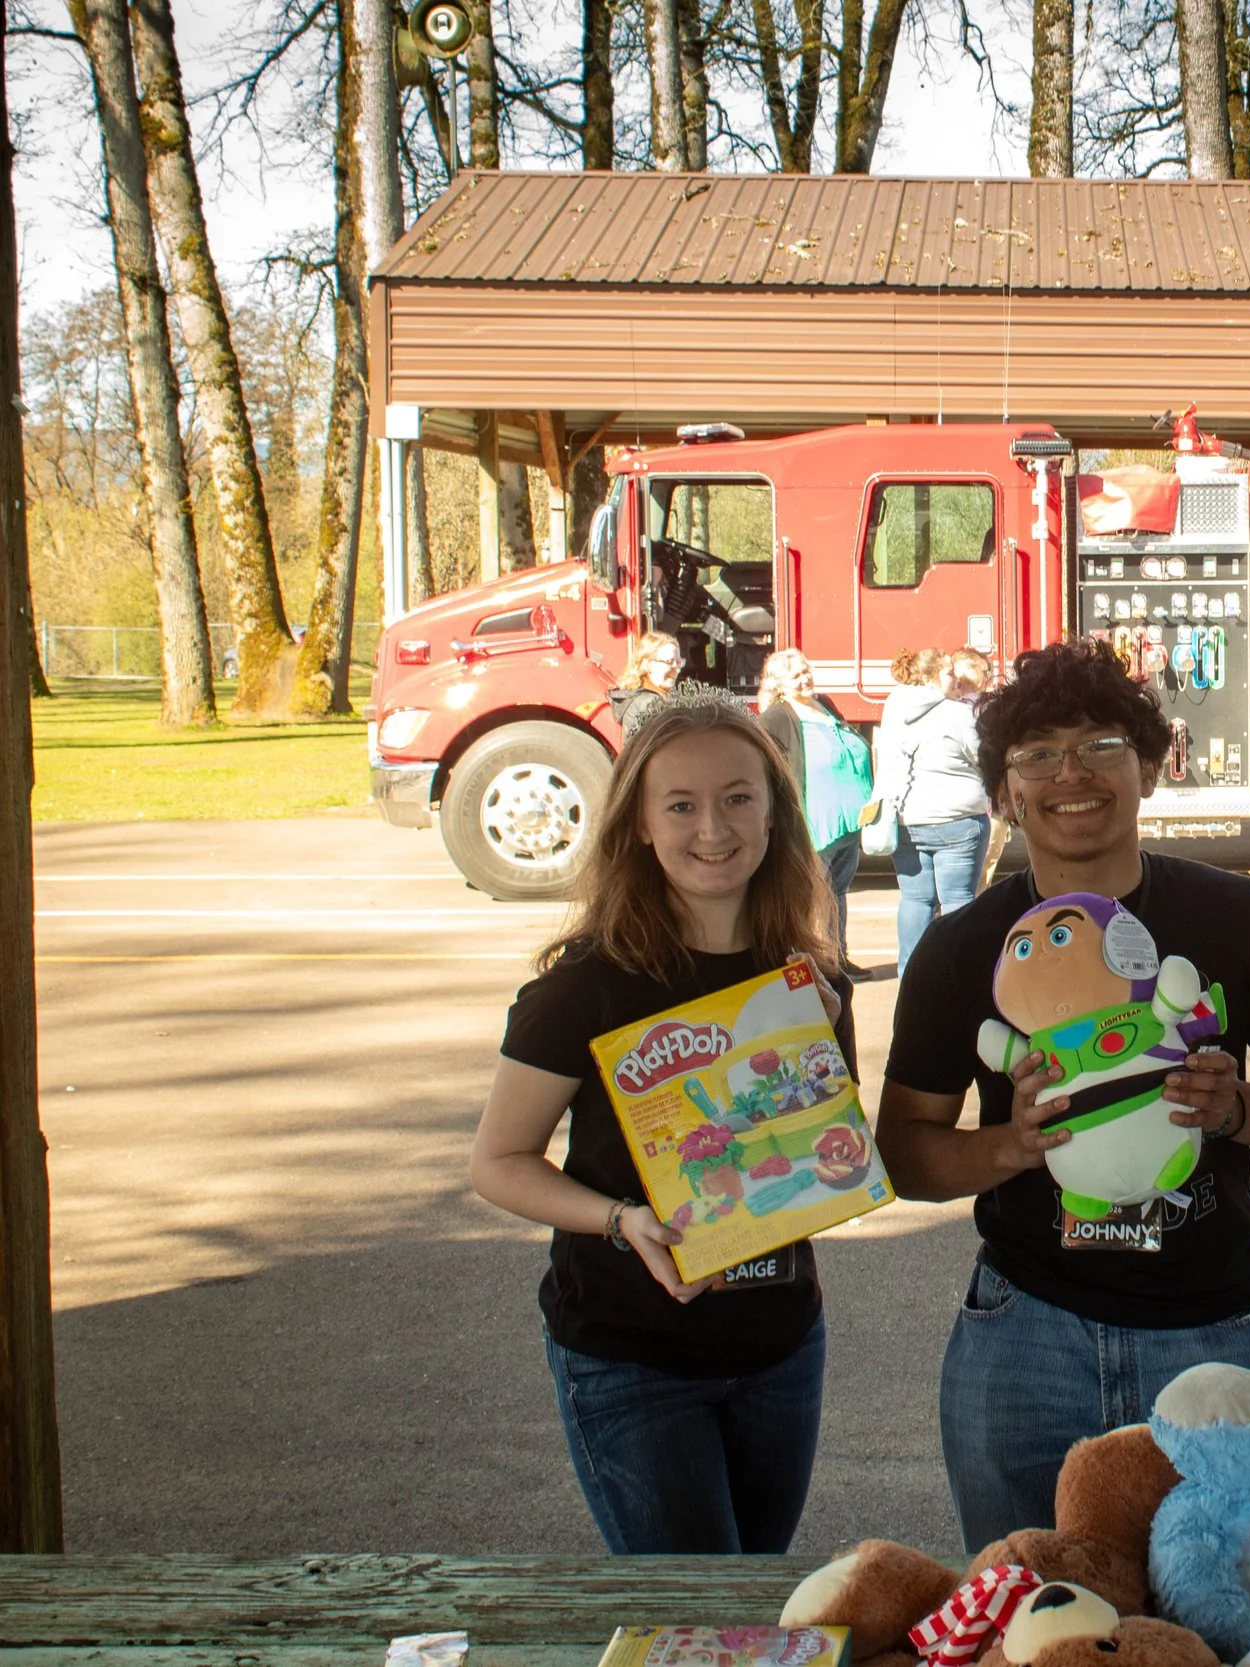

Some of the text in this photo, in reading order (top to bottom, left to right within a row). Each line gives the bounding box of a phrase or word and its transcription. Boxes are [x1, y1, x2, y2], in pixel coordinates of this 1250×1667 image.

[788, 968, 807, 986] 3+
[1100, 1008, 1142, 1029] LIGHTYEAR
[615, 1023, 728, 1088] Play-Doh
[1070, 1222, 1154, 1241] JOHNNY
[725, 1259, 777, 1282] SAIGE
